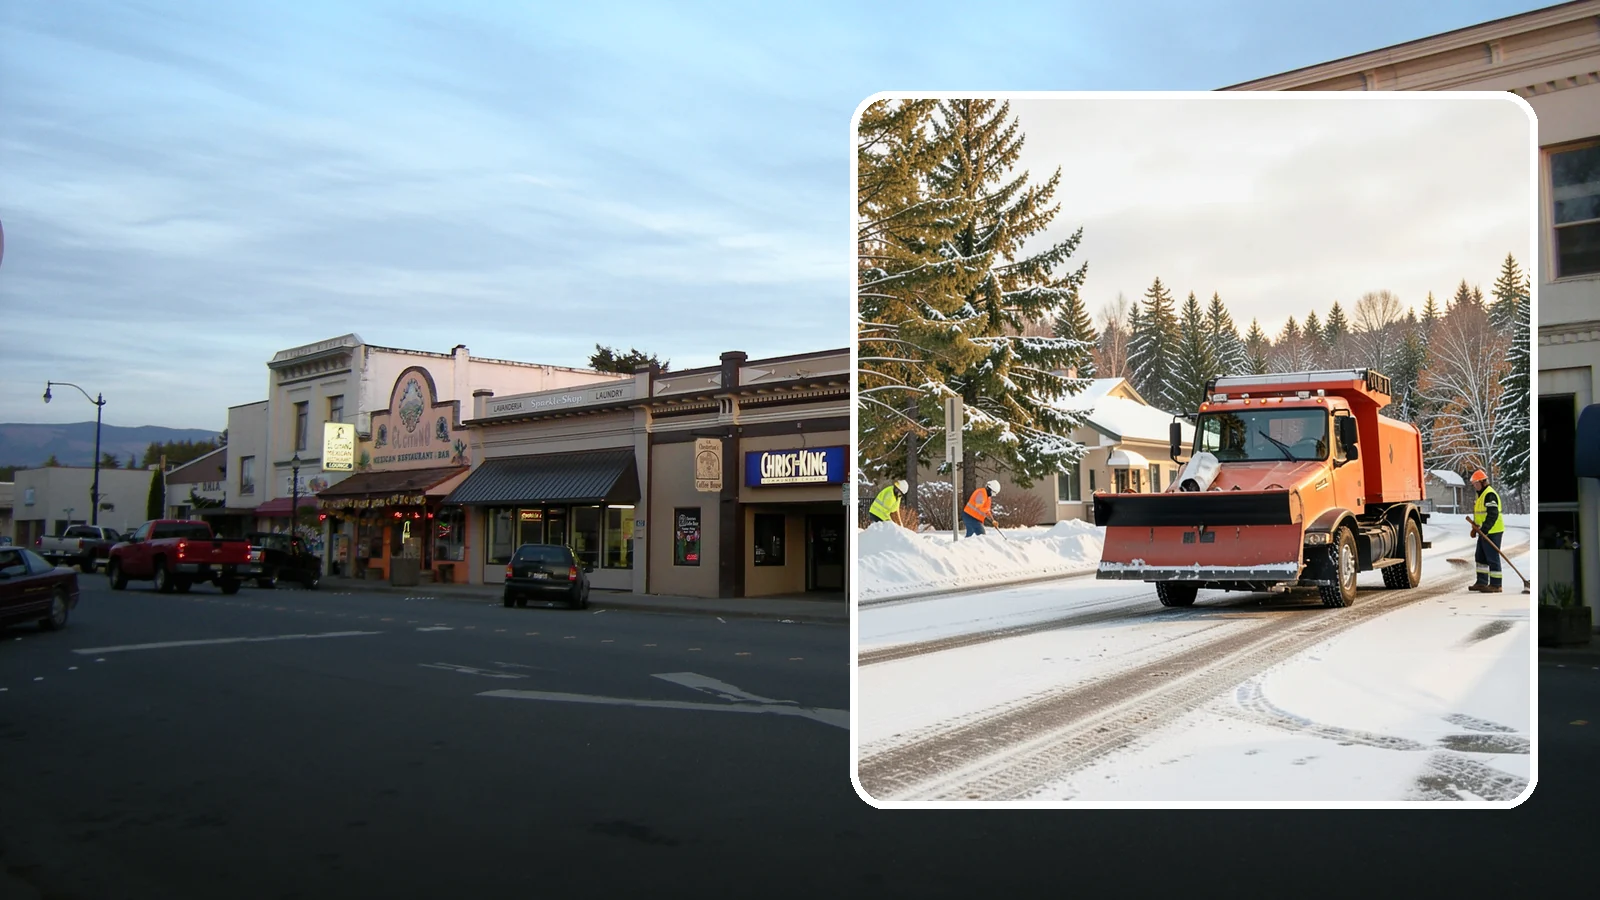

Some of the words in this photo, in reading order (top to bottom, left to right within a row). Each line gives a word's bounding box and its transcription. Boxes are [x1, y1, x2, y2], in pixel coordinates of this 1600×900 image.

[493, 402, 522, 412] LAVANDERIA
[530, 398, 561, 409] Sparkle
[562, 394, 582, 405] Shop
[595, 389, 623, 400] LAUNDRY
[373, 455, 396, 464] MEXICAN
[397, 451, 433, 462] RESTAURANT
[438, 450, 450, 459] BAR
[760, 452, 797, 478] CHRIST
[799, 450, 827, 476] KING
